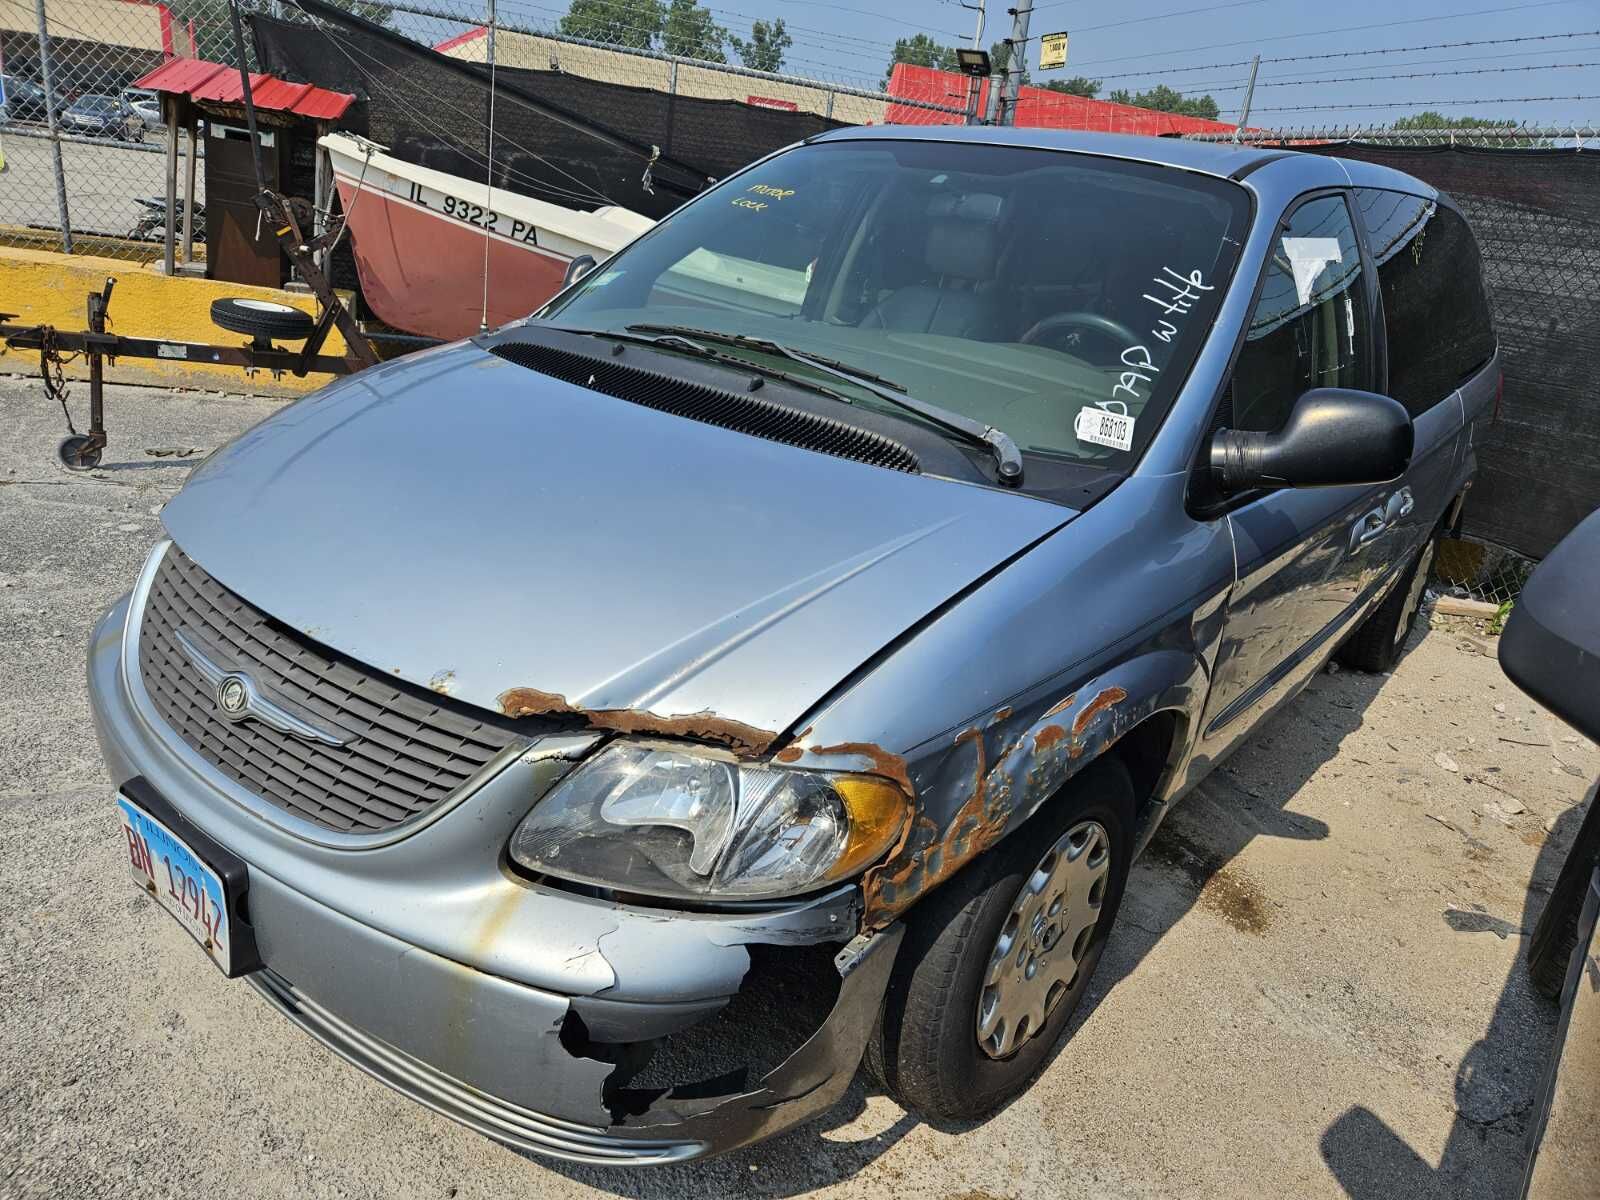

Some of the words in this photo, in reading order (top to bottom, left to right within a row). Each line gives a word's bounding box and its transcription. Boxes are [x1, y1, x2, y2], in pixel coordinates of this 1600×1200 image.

[410, 181, 427, 206] IL
[443, 195, 498, 231] 9322
[510, 219, 538, 245] PA
[1099, 416, 1127, 440] 868103
[123, 823, 155, 881] BN
